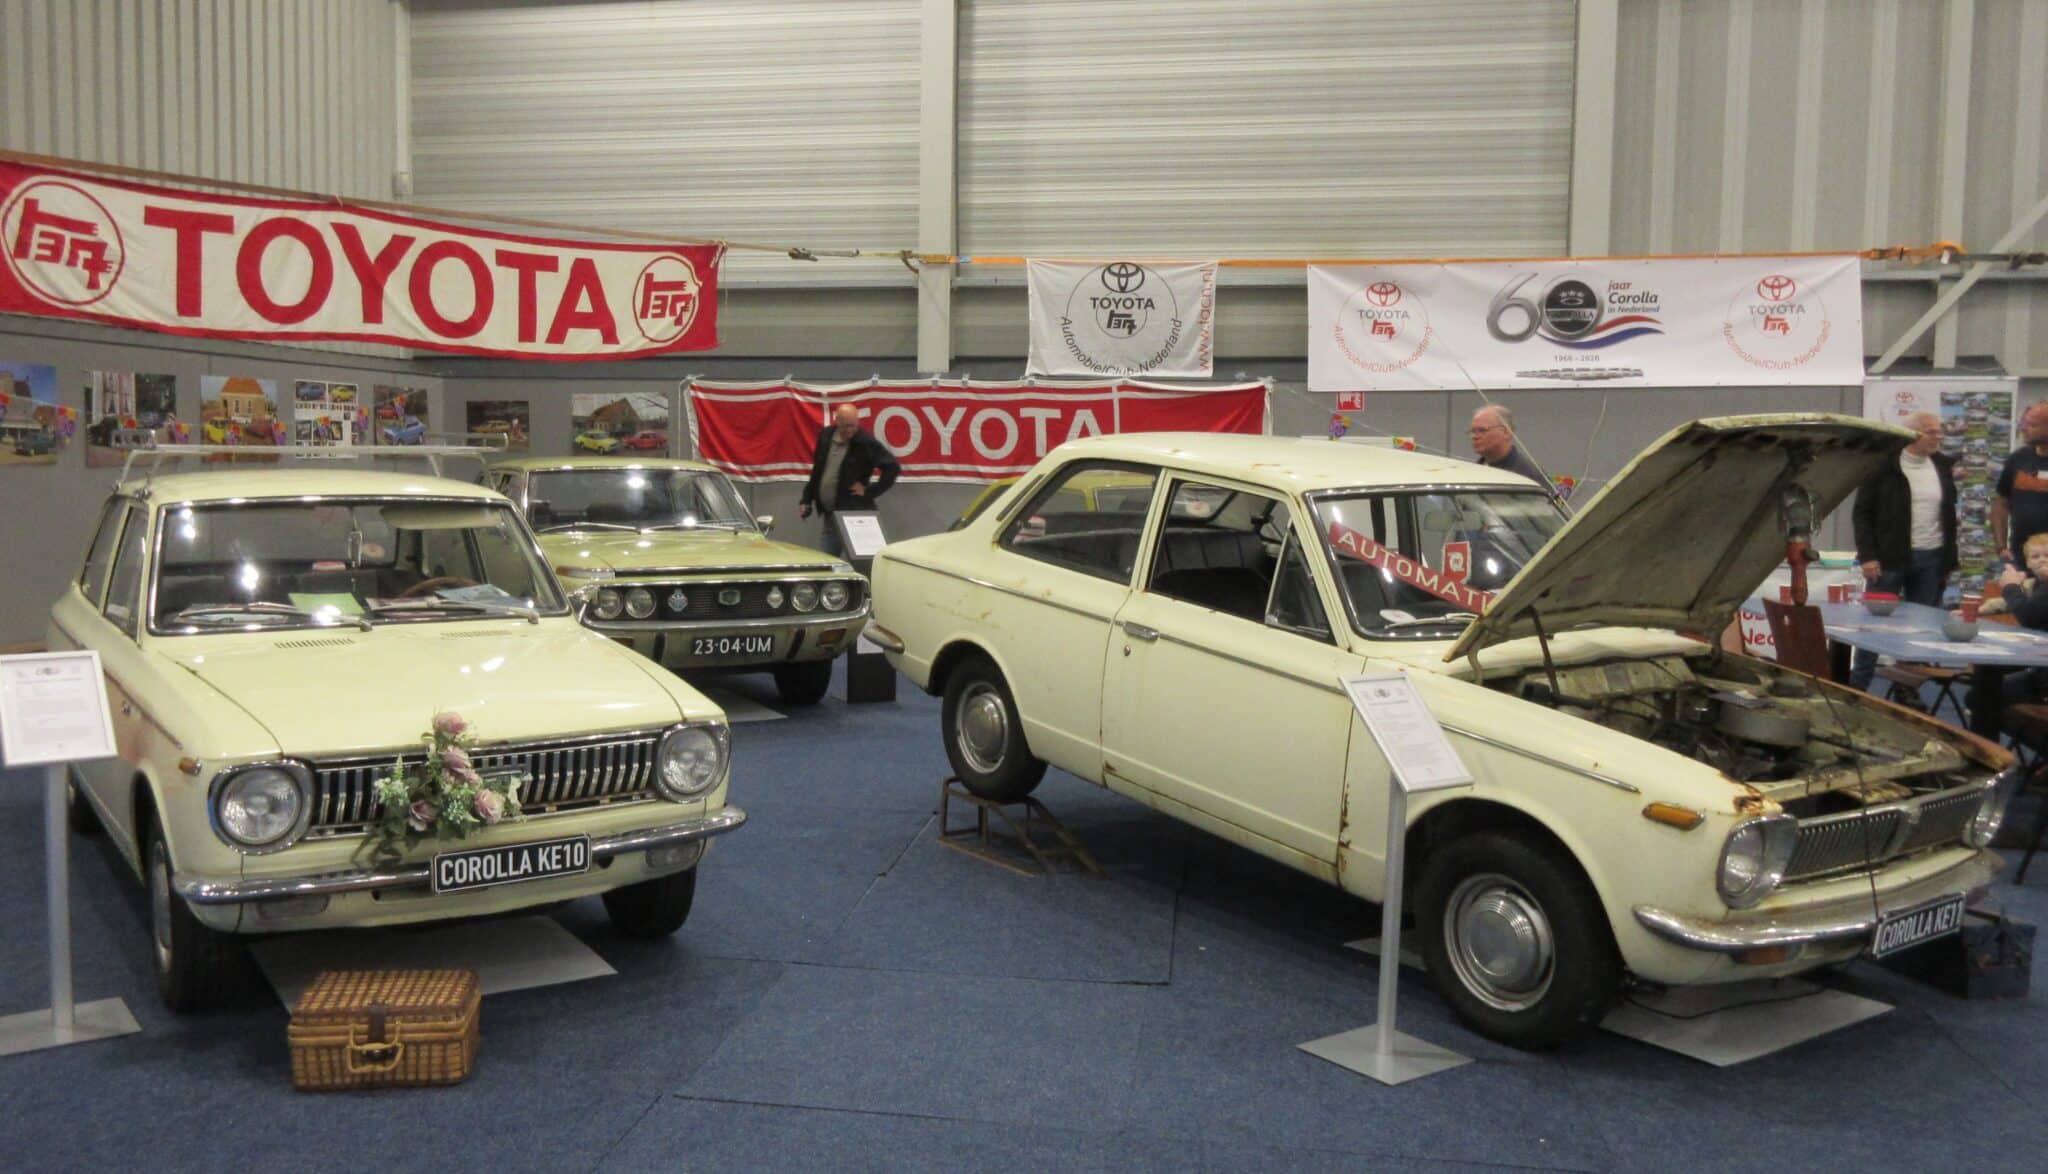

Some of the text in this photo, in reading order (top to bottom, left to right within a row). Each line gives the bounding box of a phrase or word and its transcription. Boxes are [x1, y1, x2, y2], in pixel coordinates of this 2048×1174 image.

[143, 205, 619, 345] TOYOTA
[1607, 280, 1633, 292] jaar
[1089, 297, 1156, 311] TOYOTA
[1607, 290, 1659, 305] Corolla
[1357, 309, 1411, 320] TOYOTA
[1607, 305, 1661, 314] in Nederland
[1748, 304, 1807, 316] TOYOTA
[833, 406, 1103, 460] OYOTA
[694, 637, 773, 656] 23-04-UM
[440, 842, 585, 886] COROLLA KE10
[1880, 910, 1933, 951] COROLLA
